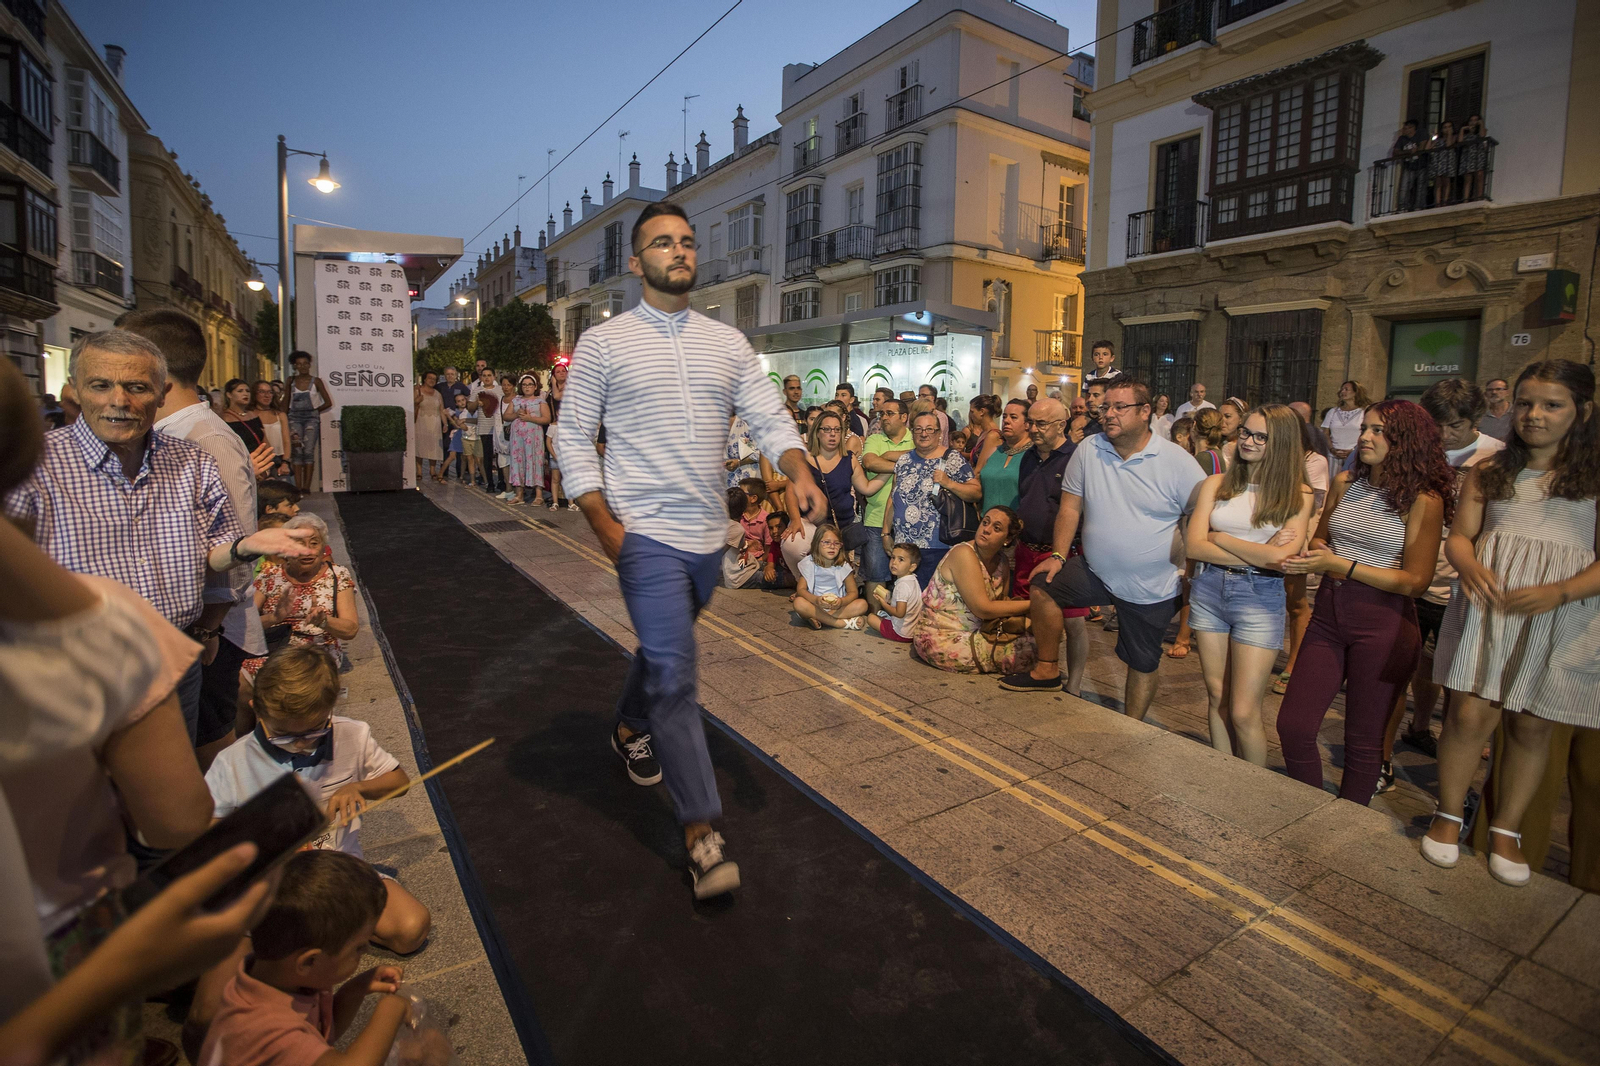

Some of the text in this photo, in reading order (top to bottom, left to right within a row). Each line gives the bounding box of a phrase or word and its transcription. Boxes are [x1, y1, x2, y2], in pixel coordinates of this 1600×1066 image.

[326, 264, 338, 273] SR
[348, 266, 360, 275] SR
[370, 268, 382, 277] SR
[391, 270, 403, 279] SR
[337, 281, 350, 289] SR
[359, 282, 371, 291] SR
[381, 284, 393, 293] SR
[326, 295, 339, 304] SR
[349, 297, 361, 305] SR
[371, 299, 383, 307] SR
[392, 300, 403, 308] SR
[338, 311, 350, 320] SR
[360, 313, 372, 321] SR
[382, 314, 393, 322] SR
[328, 326, 340, 334] SR
[350, 327, 362, 335] SR
[371, 329, 383, 337] SR
[392, 330, 404, 338] SR
[1513, 335, 1528, 344] 76
[339, 342, 352, 350] SR
[361, 343, 373, 351] SR
[908, 347, 920, 355] DEL
[1414, 362, 1459, 373] Unicaja
[329, 370, 405, 387] SEÑOR
